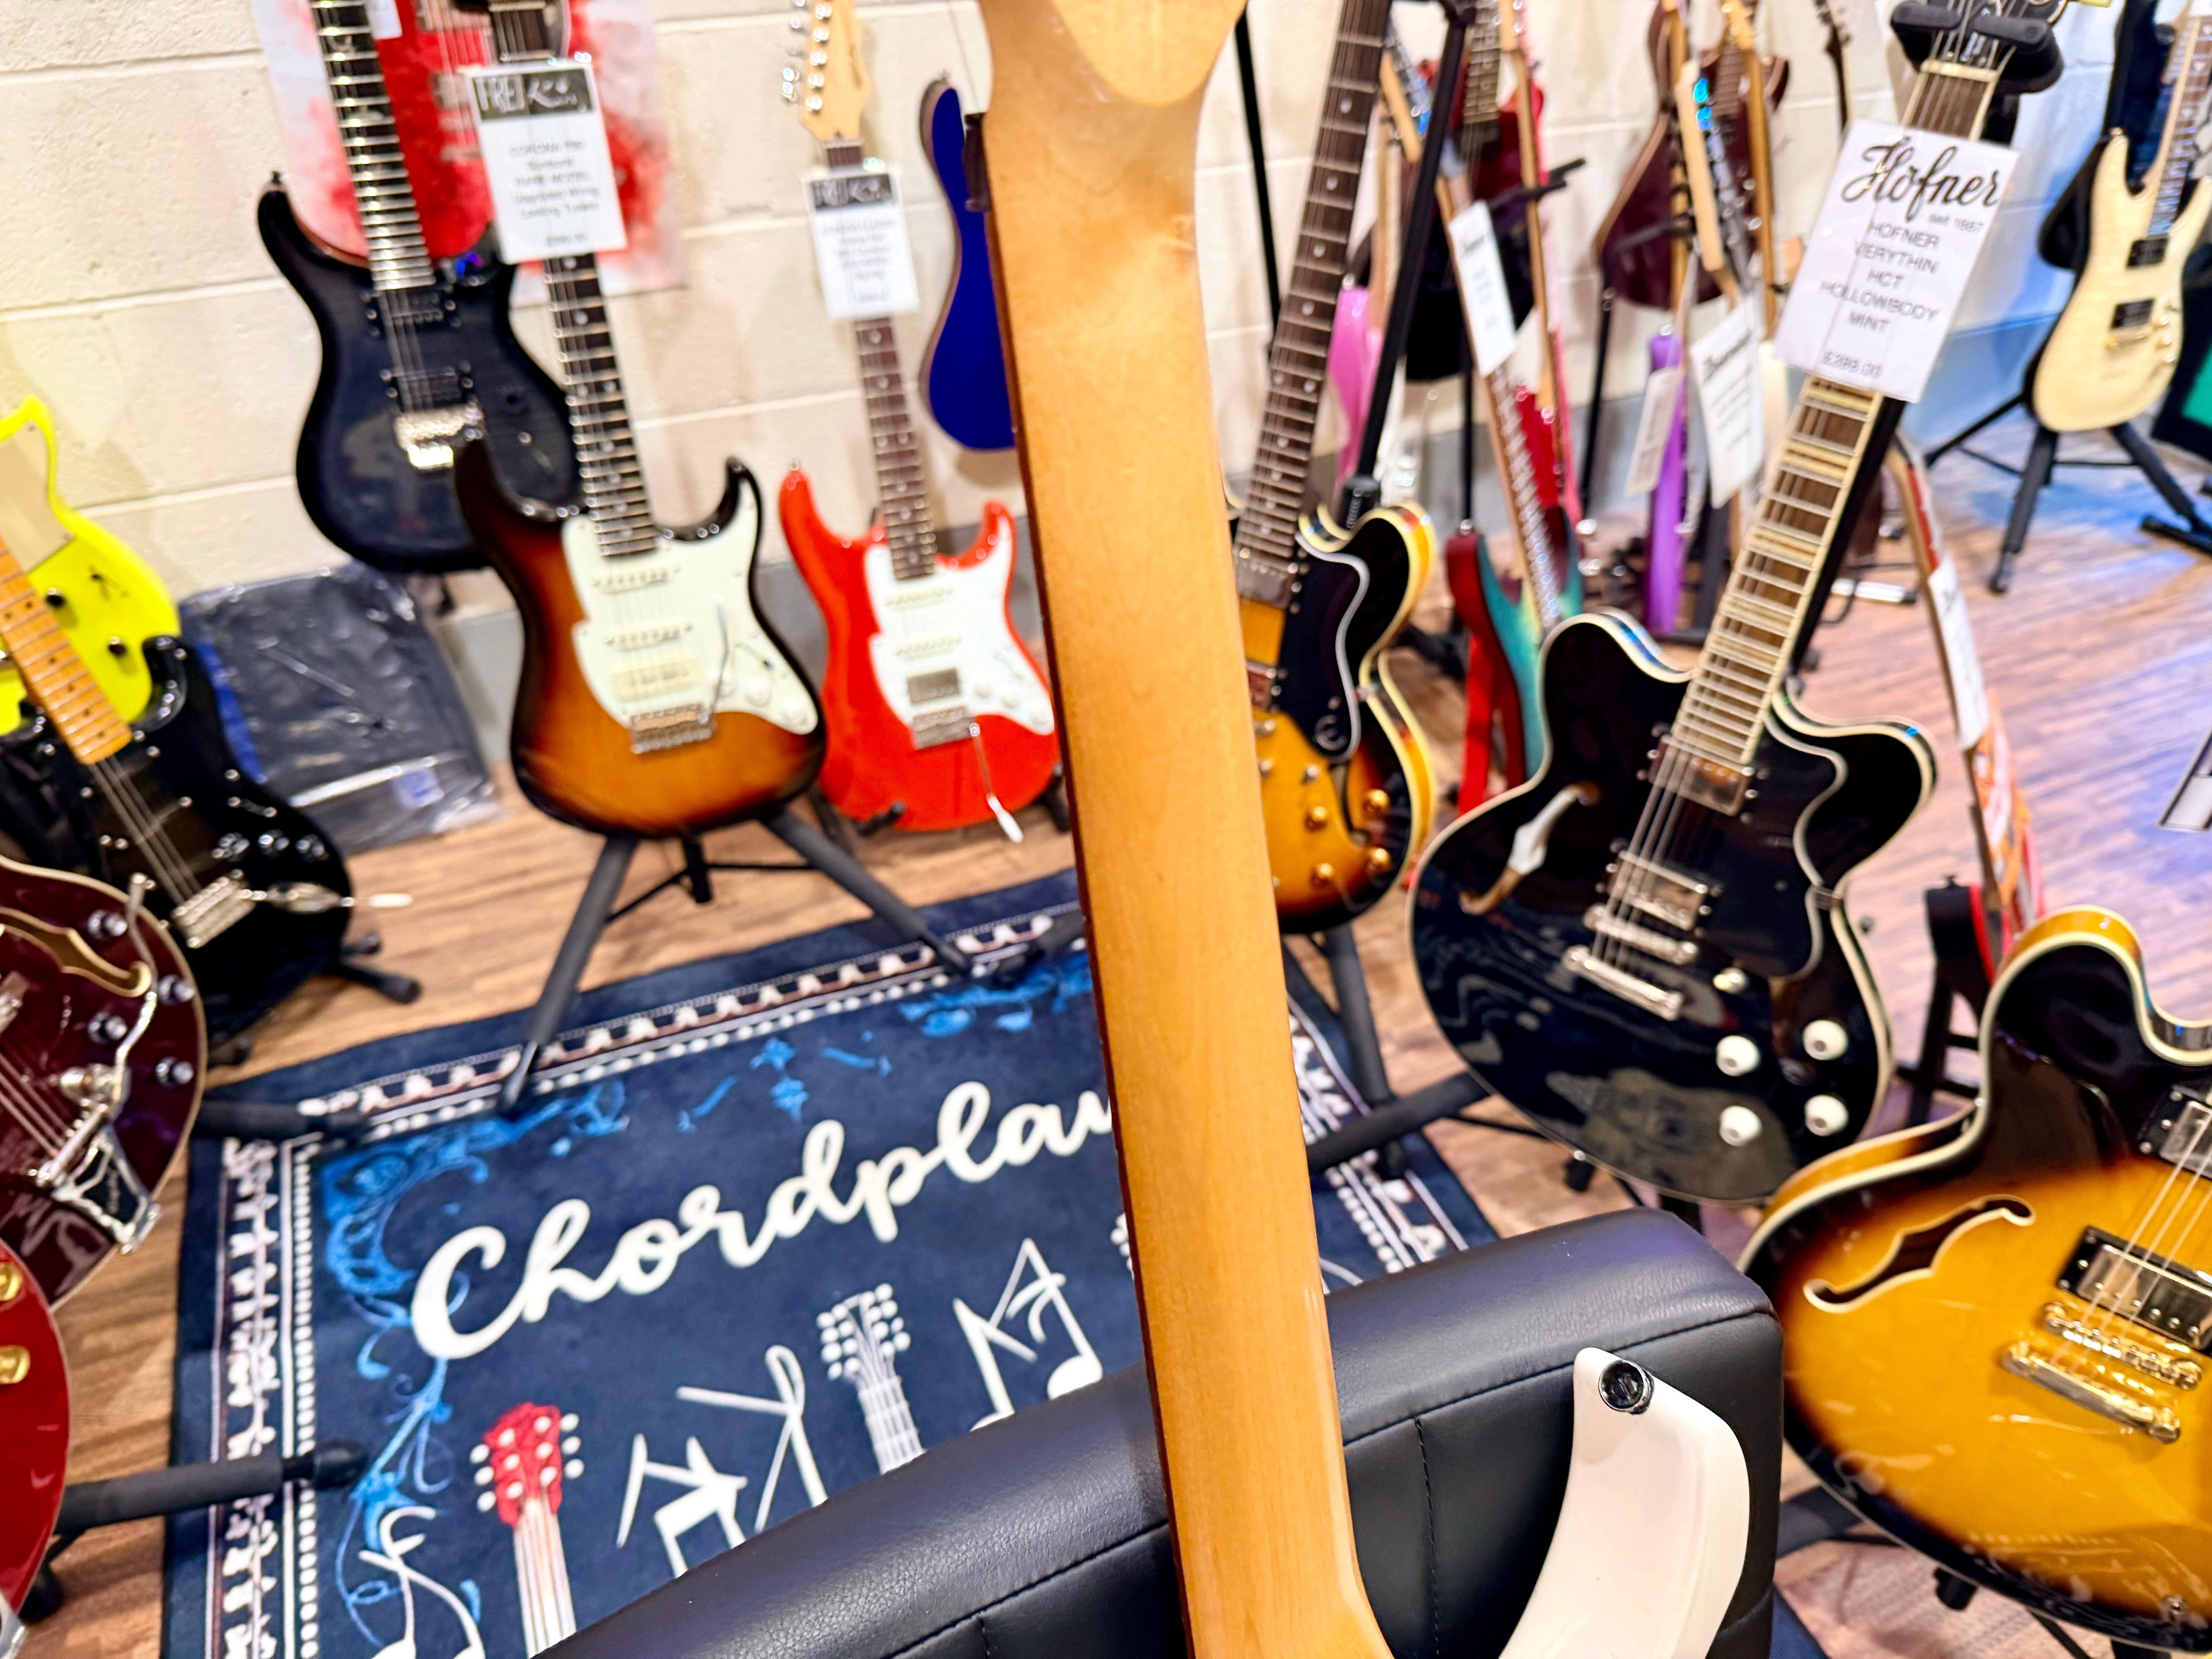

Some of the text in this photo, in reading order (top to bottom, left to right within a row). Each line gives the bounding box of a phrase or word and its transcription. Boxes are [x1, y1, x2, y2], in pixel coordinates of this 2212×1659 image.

[1868, 222, 1940, 248] HOFNER
[1866, 268, 1905, 289] HCT
[1820, 280, 1941, 321] HOLLOWBODY
[1848, 311, 1890, 331] MINT
